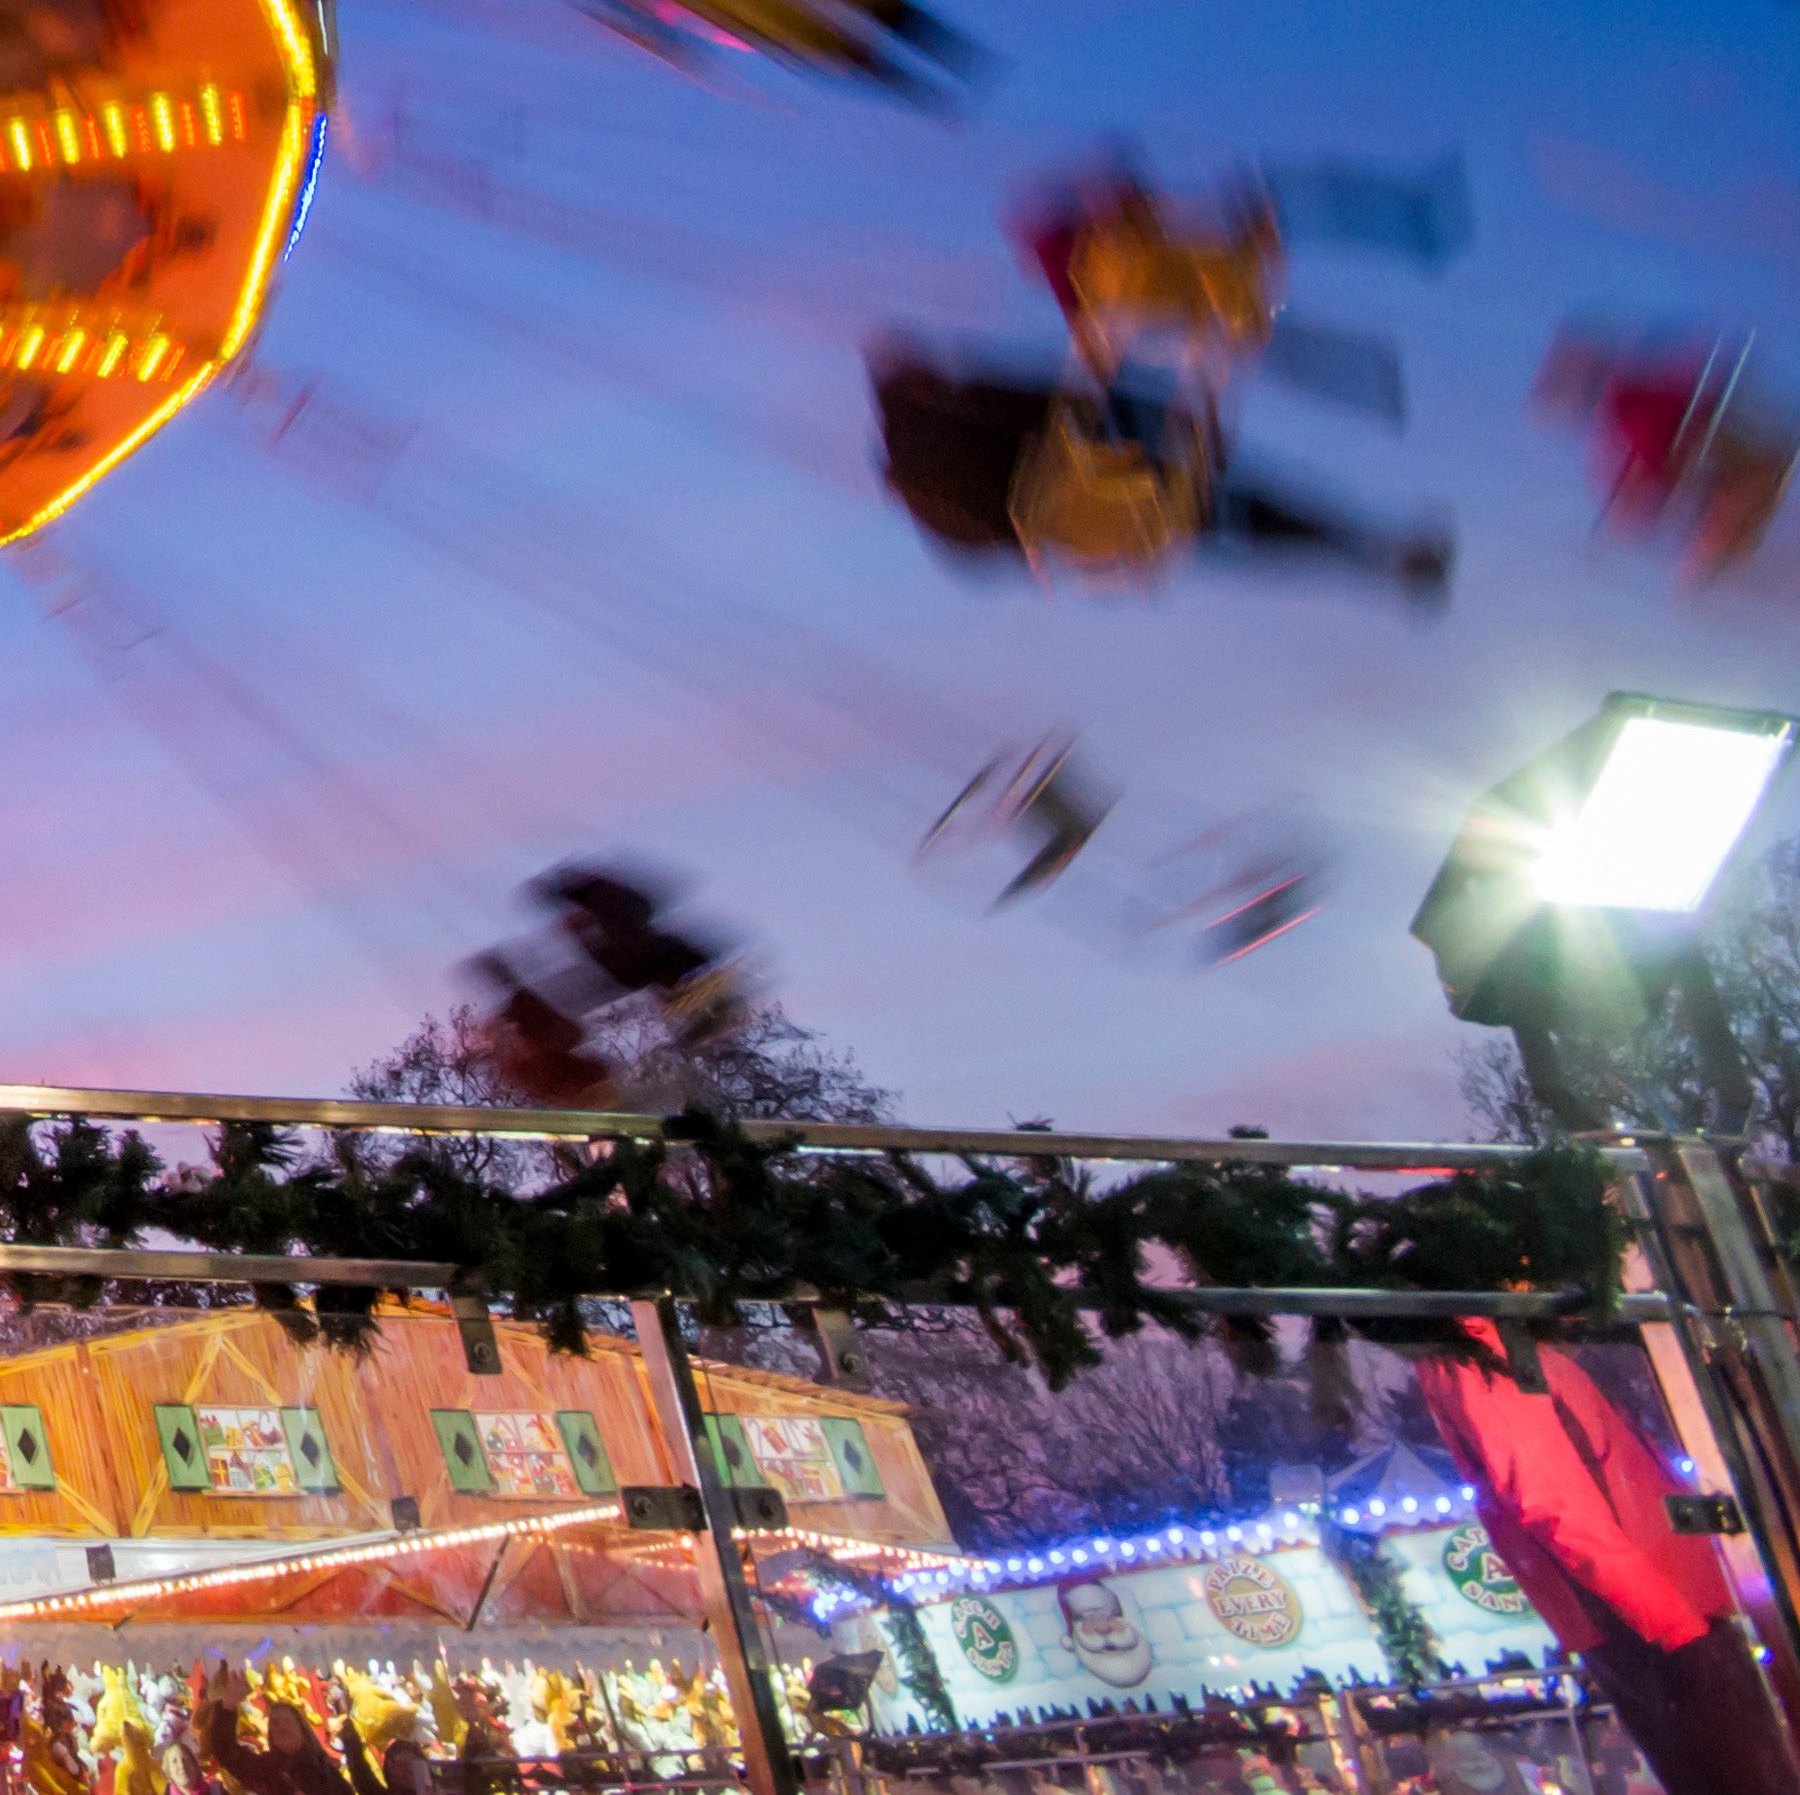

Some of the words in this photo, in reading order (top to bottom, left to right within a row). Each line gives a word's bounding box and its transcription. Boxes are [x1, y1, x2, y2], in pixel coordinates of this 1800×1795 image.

[1447, 1526, 1488, 1571] CAT
[1206, 1557, 1277, 1593] PRIZE
[1213, 1588, 1288, 1617] EVERY
[1461, 1580, 1527, 1612] SAN
[972, 1621, 995, 1651] A
[1232, 1610, 1293, 1644] TIME
